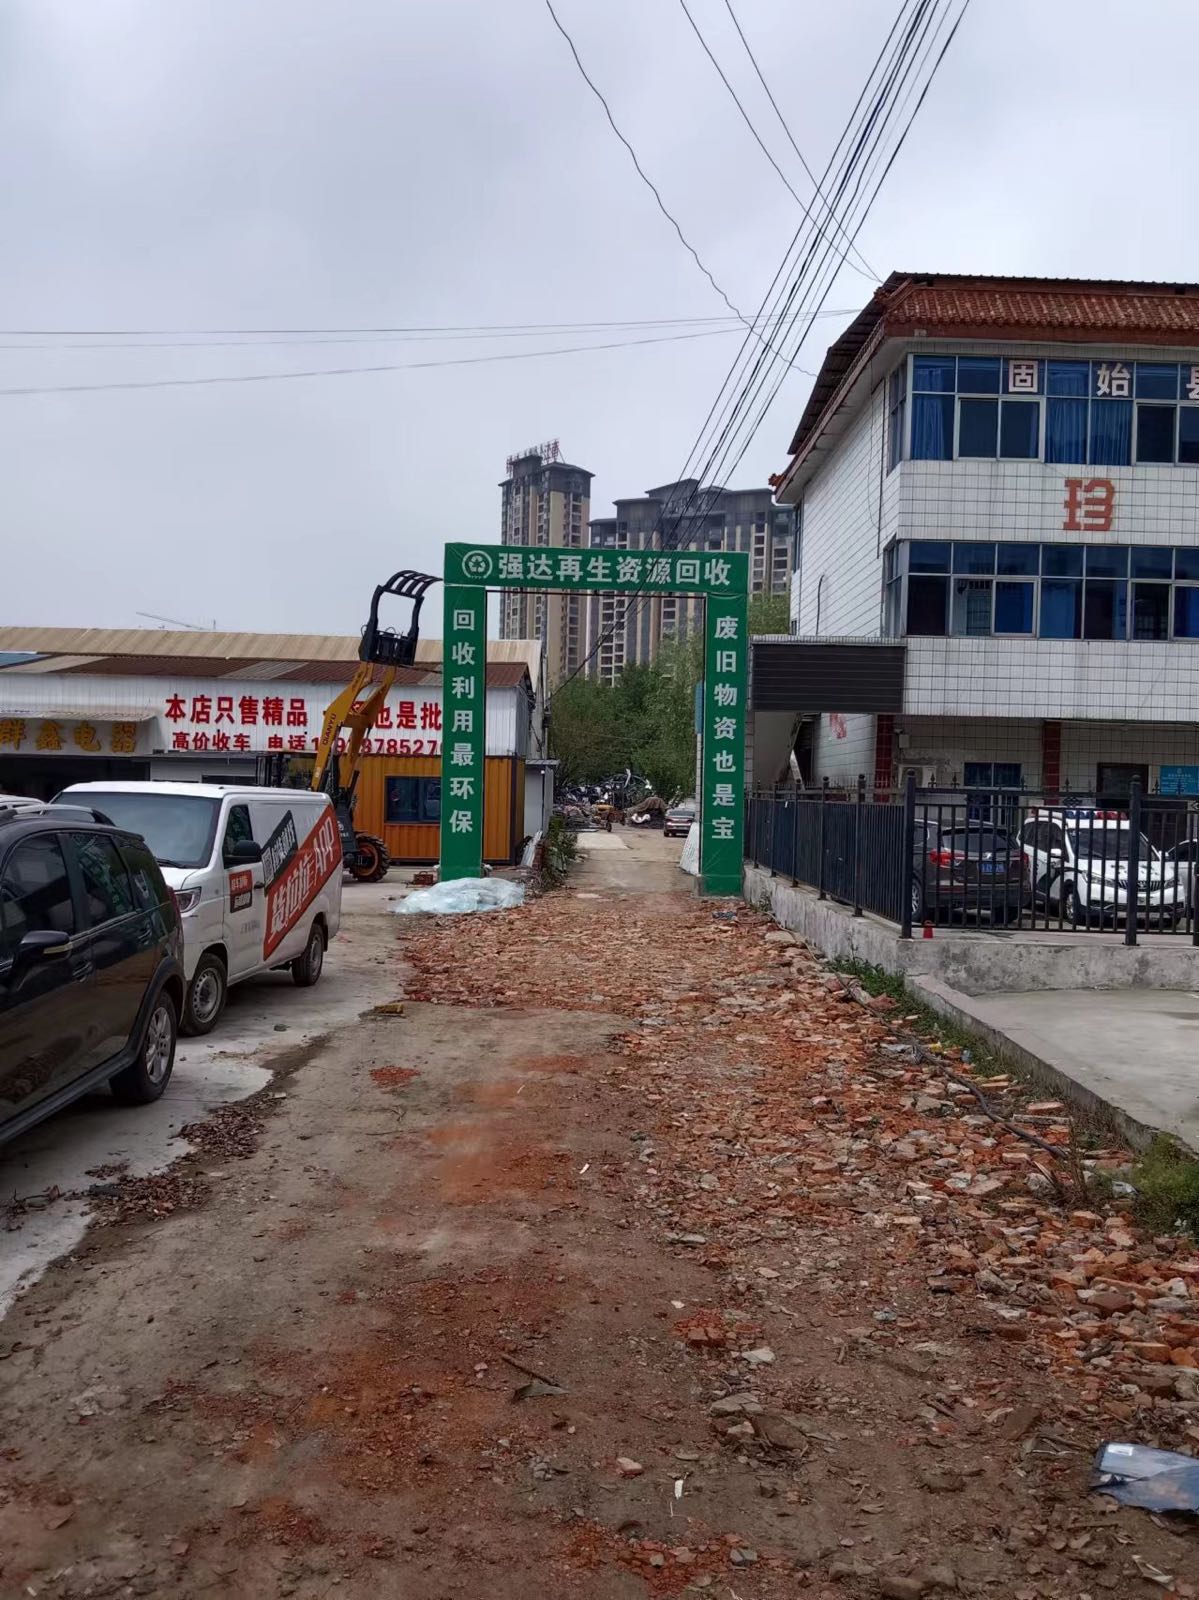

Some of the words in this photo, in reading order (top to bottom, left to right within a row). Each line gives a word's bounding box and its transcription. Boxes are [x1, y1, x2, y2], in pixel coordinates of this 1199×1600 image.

[498, 552, 732, 587] 强达再生资源回收
[164, 693, 308, 727] 本店只售精品
[449, 608, 476, 834] 回收利用最环保
[712, 615, 740, 840] 废旧物资也是宝
[172, 729, 251, 752] 高价收车
